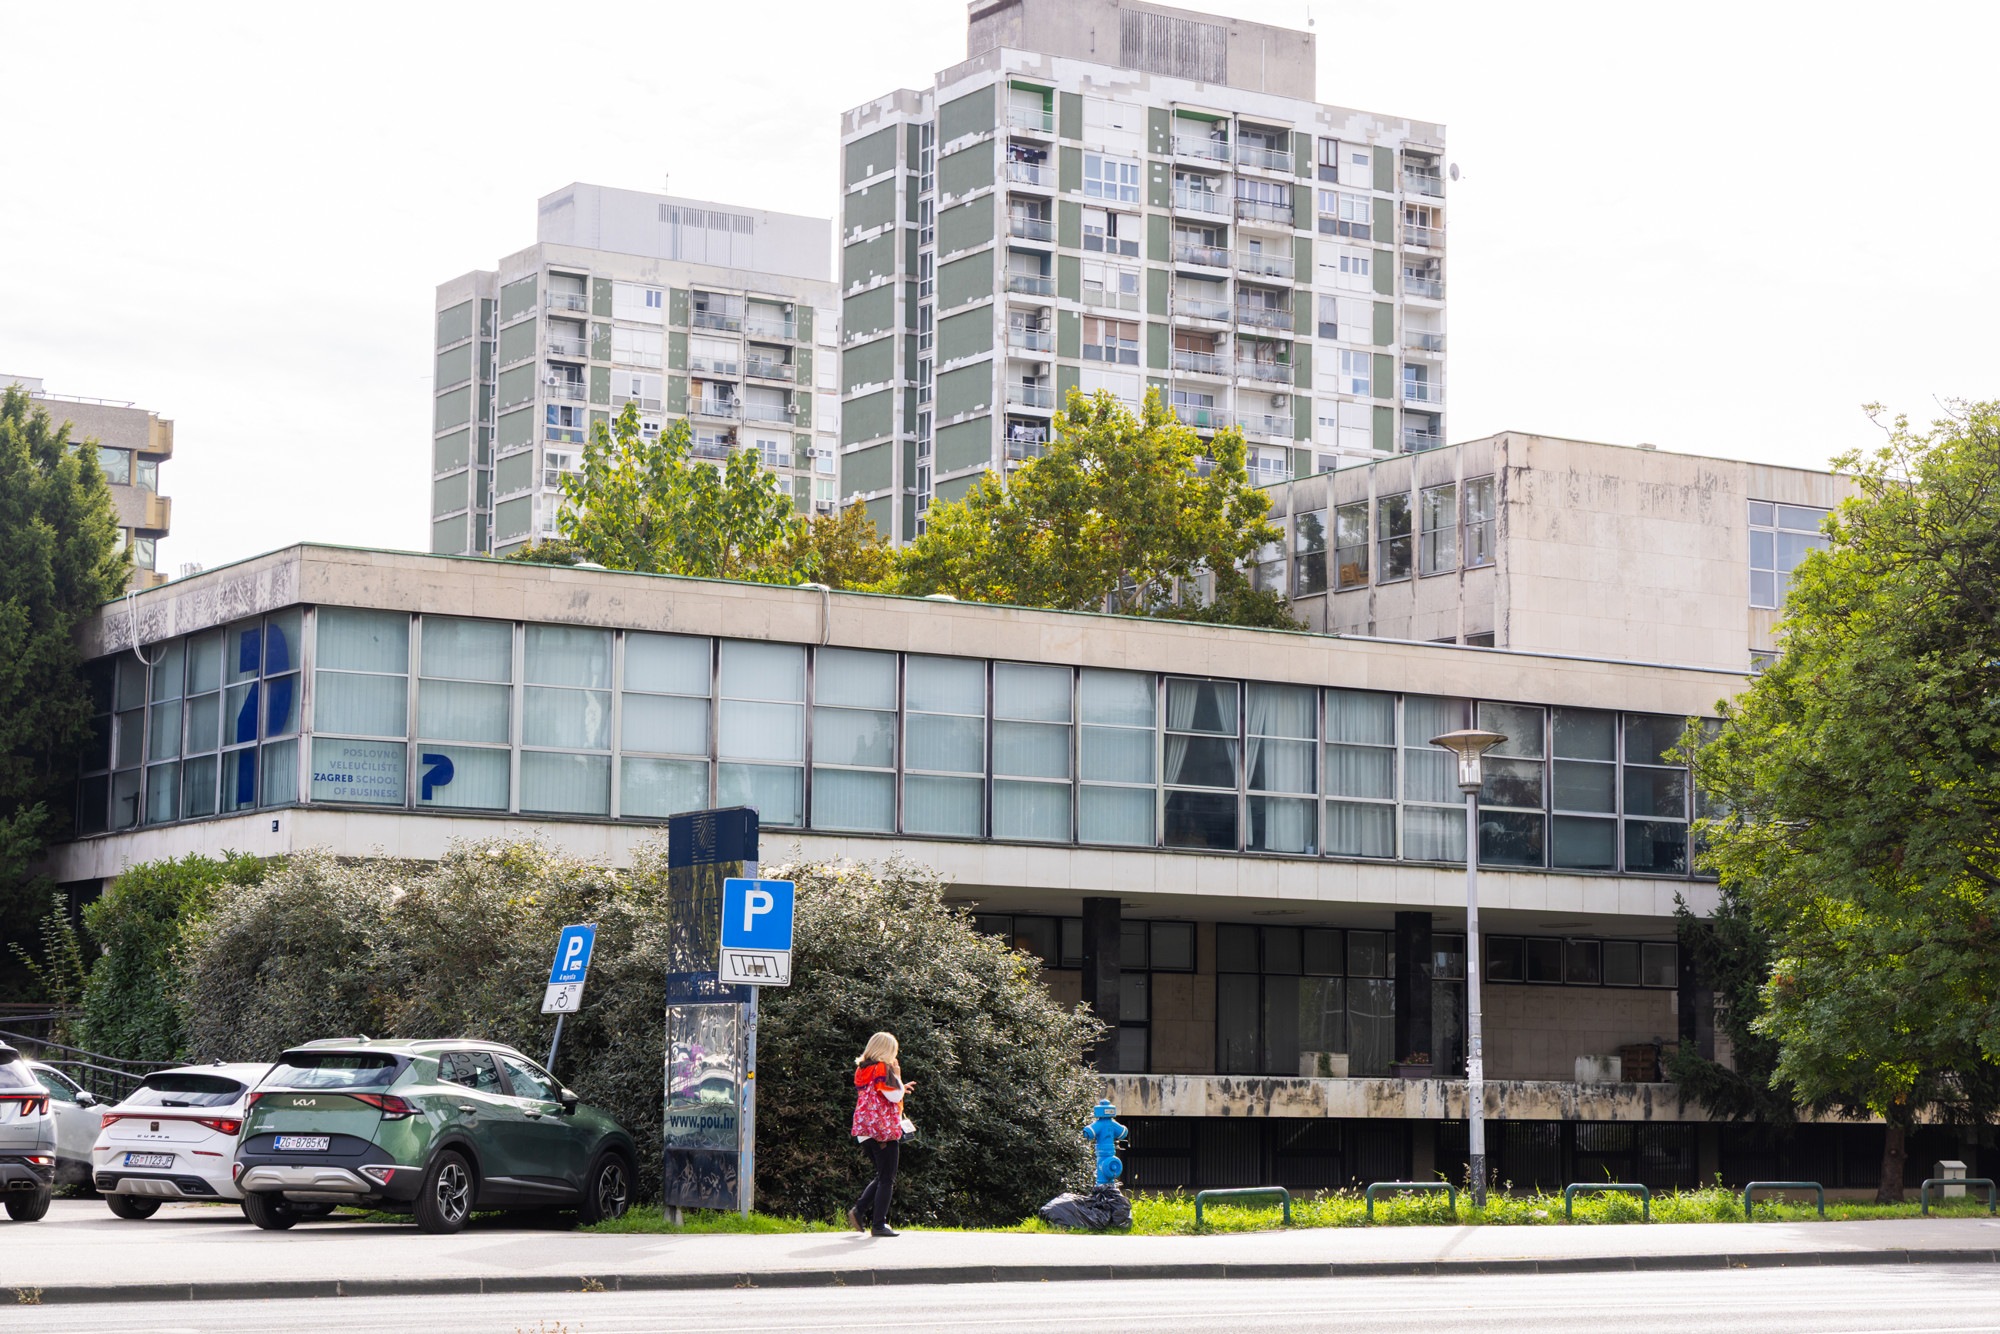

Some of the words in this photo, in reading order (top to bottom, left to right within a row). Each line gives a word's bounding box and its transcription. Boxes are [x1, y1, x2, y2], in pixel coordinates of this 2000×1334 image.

[343, 748, 399, 760] POSLOVNO
[329, 760, 398, 772] VELEUČILIŠTE
[314, 773, 354, 783] ZAGREB
[356, 775, 398, 785] SCHOOL
[334, 787, 347, 796] OF
[350, 788, 398, 798] BUSINESS
[671, 898, 722, 919] OTVORE
[743, 890, 774, 931] P
[562, 936, 583, 971] P
[670, 1113, 735, 1132] www.pou.hr
[280, 1137, 291, 1148] ZG
[130, 1154, 140, 1165] ZG
